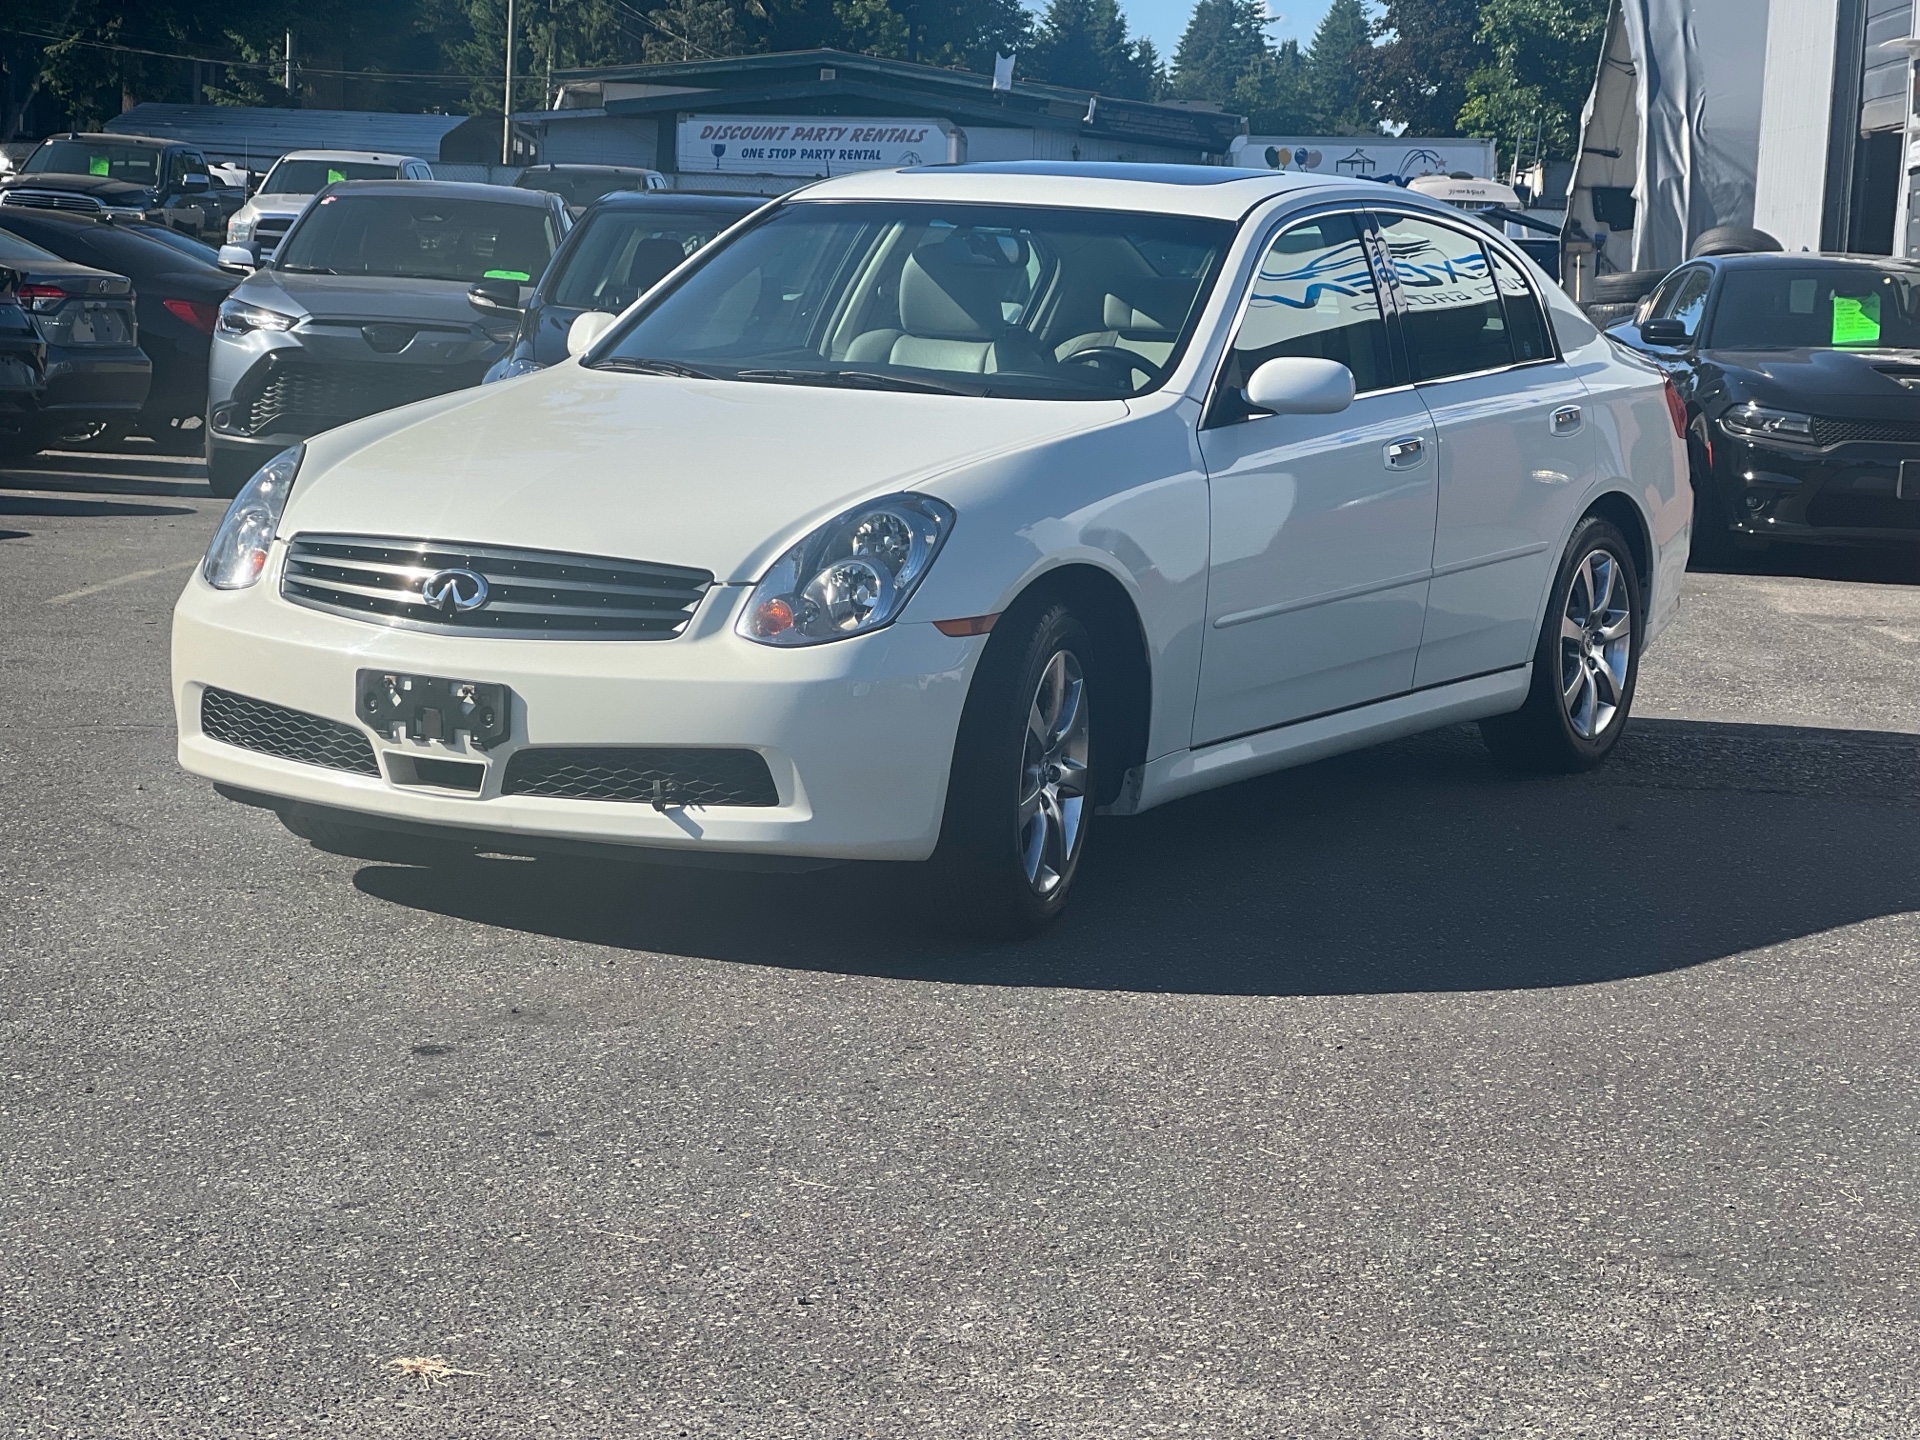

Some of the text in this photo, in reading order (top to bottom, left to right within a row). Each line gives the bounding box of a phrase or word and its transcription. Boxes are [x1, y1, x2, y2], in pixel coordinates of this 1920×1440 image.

[700, 125, 929, 143] DISCOUNT PARTY RENTALS
[741, 147, 881, 160] ONE STOP PARTY RENTAL
